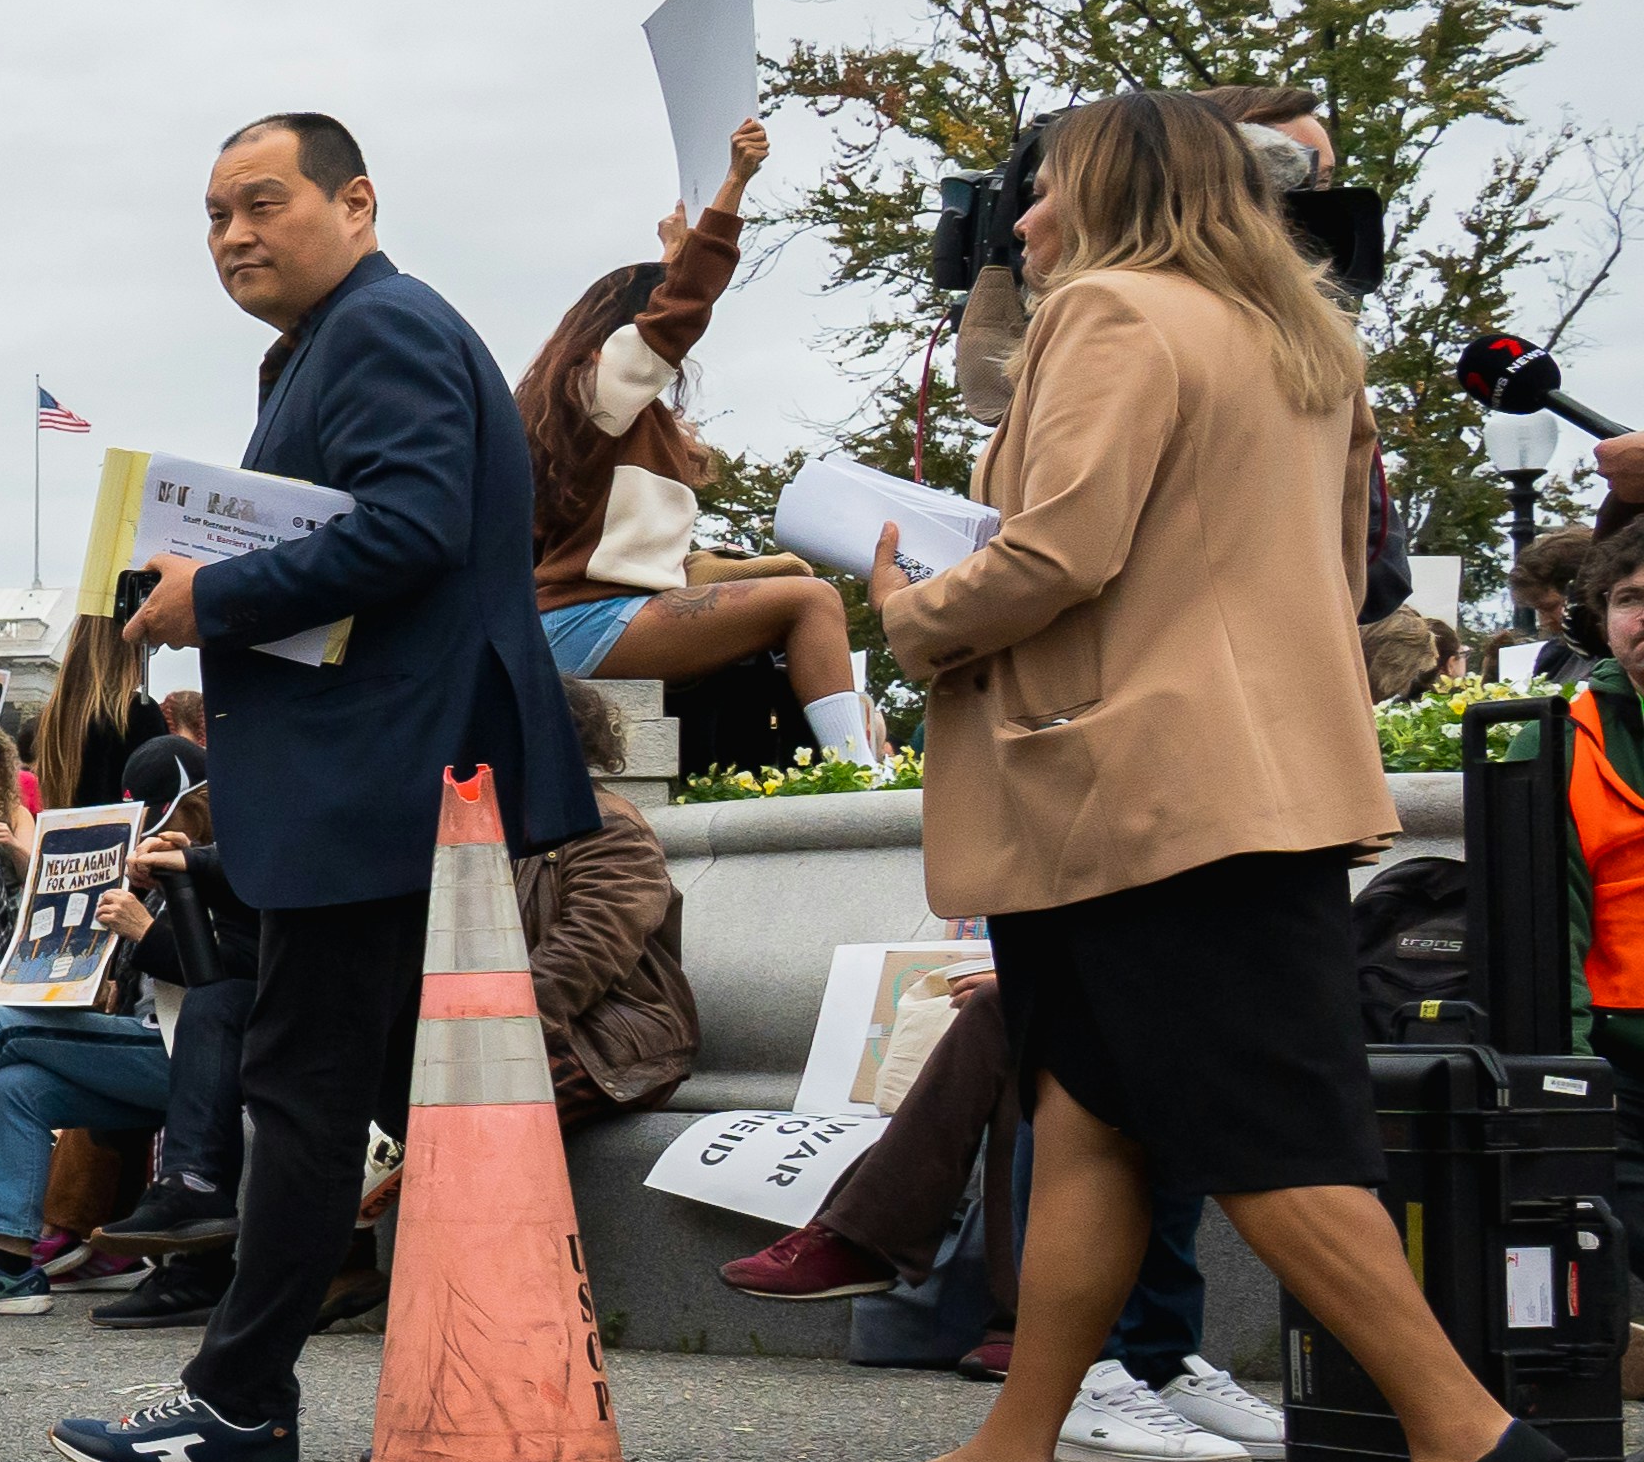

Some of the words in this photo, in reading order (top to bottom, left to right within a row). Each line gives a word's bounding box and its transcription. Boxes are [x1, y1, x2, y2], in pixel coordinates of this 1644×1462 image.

[1506, 348, 1547, 373] NEWS
[182, 515, 201, 525] Staff
[45, 856, 80, 877] NEVER
[83, 849, 117, 872] AGAIN
[46, 877, 65, 891] FOR
[69, 869, 110, 889] ANYONE
[1401, 938, 1464, 952] trans
[766, 1123, 860, 1187] WAR
